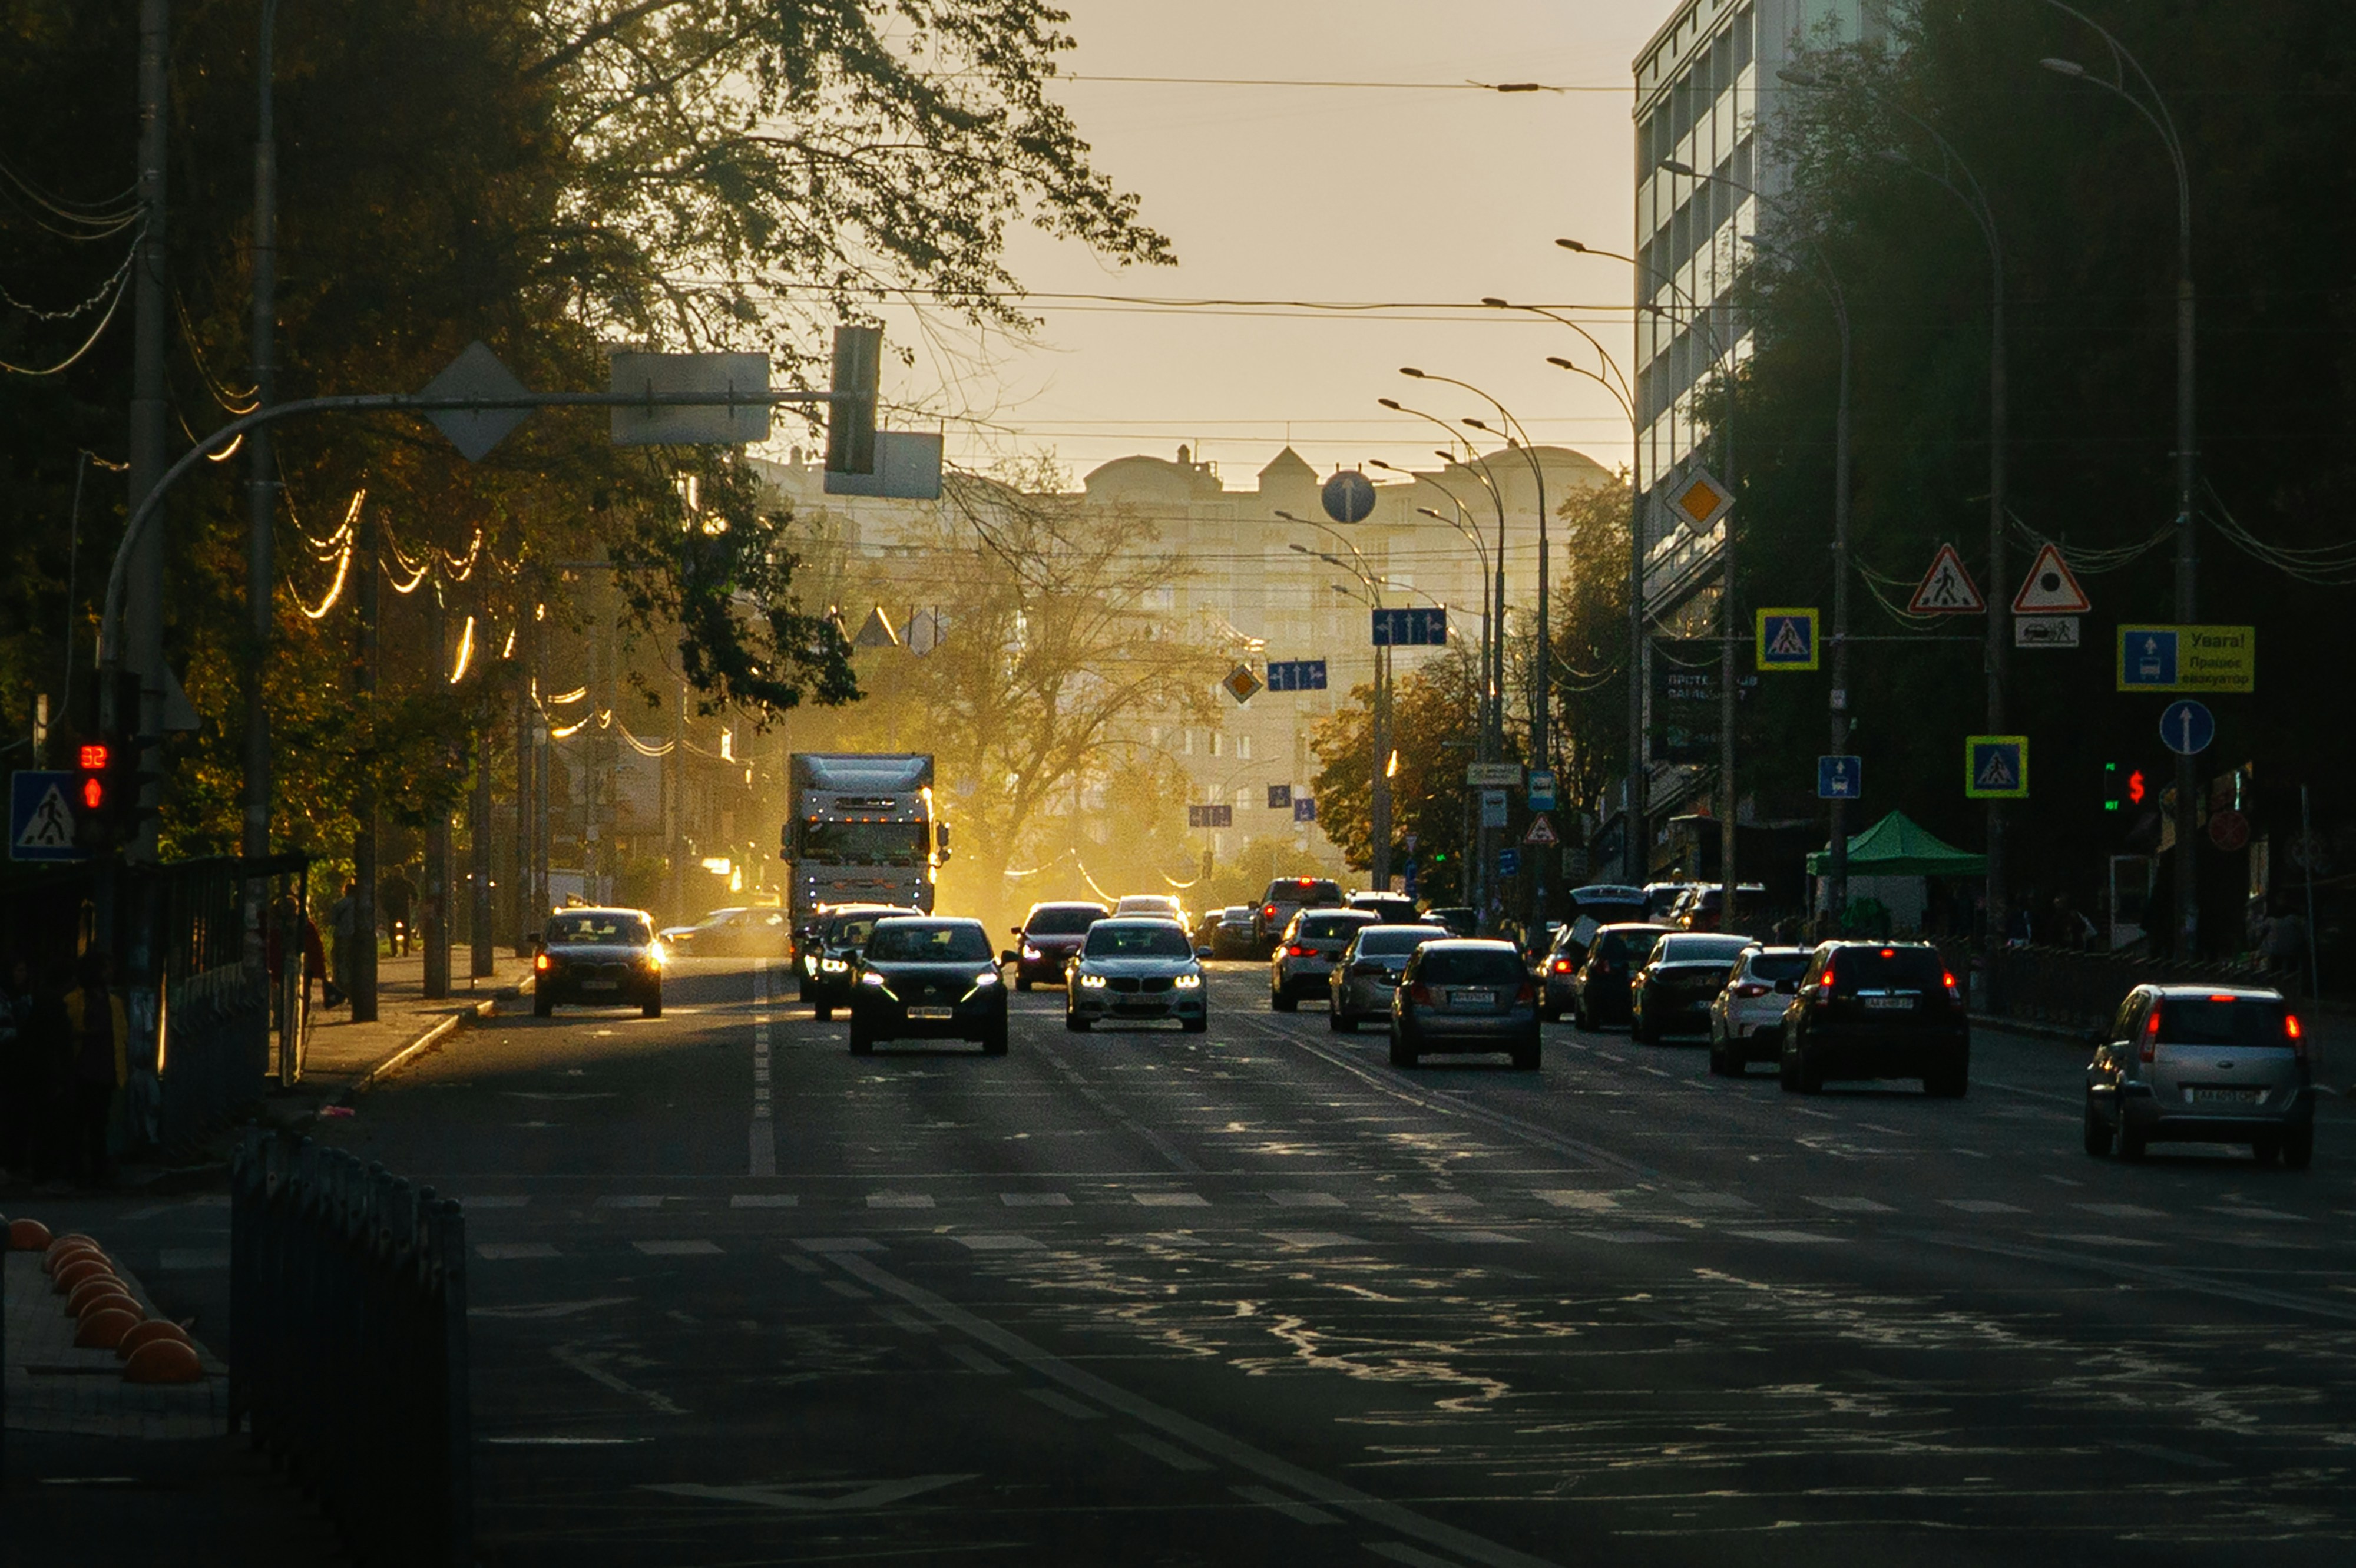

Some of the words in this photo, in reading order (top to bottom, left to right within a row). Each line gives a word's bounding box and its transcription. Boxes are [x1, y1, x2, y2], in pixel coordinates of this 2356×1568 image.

[2191, 632, 2245, 649] Увага!
[2189, 656, 2242, 670] Працює
[2181, 675, 2249, 686] евакуатор
[81, 745, 107, 768] 32
